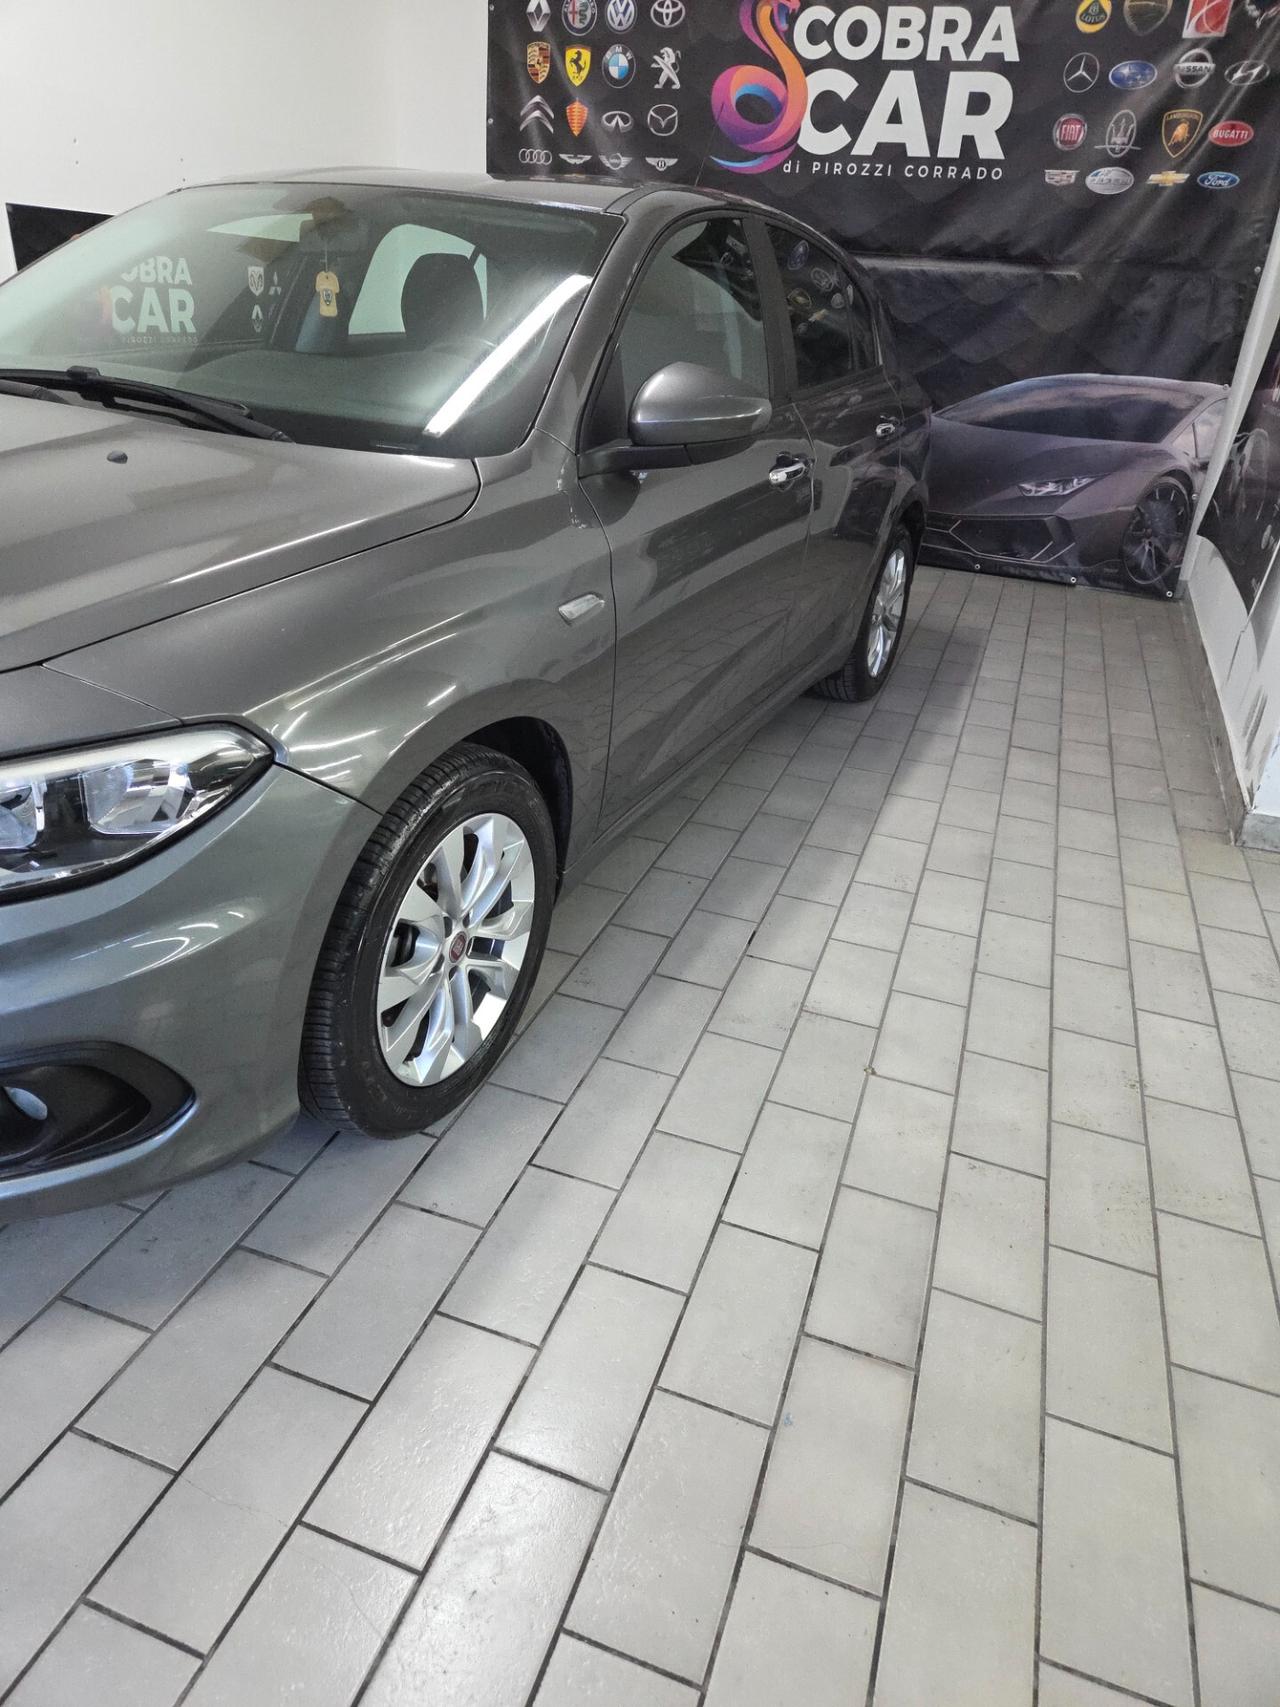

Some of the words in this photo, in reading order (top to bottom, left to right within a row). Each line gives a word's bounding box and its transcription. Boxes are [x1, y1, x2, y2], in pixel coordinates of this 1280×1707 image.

[793, 5, 1020, 62] COBRA
[796, 67, 1014, 160] CAR
[1060, 124, 1081, 141] FIAT
[1212, 129, 1249, 140] BUGATTI
[783, 160, 801, 173] di
[811, 162, 892, 177] PIROZZI
[904, 165, 1003, 180] CORRADO
[1204, 174, 1232, 186] Ford
[111, 285, 196, 333] CAR
